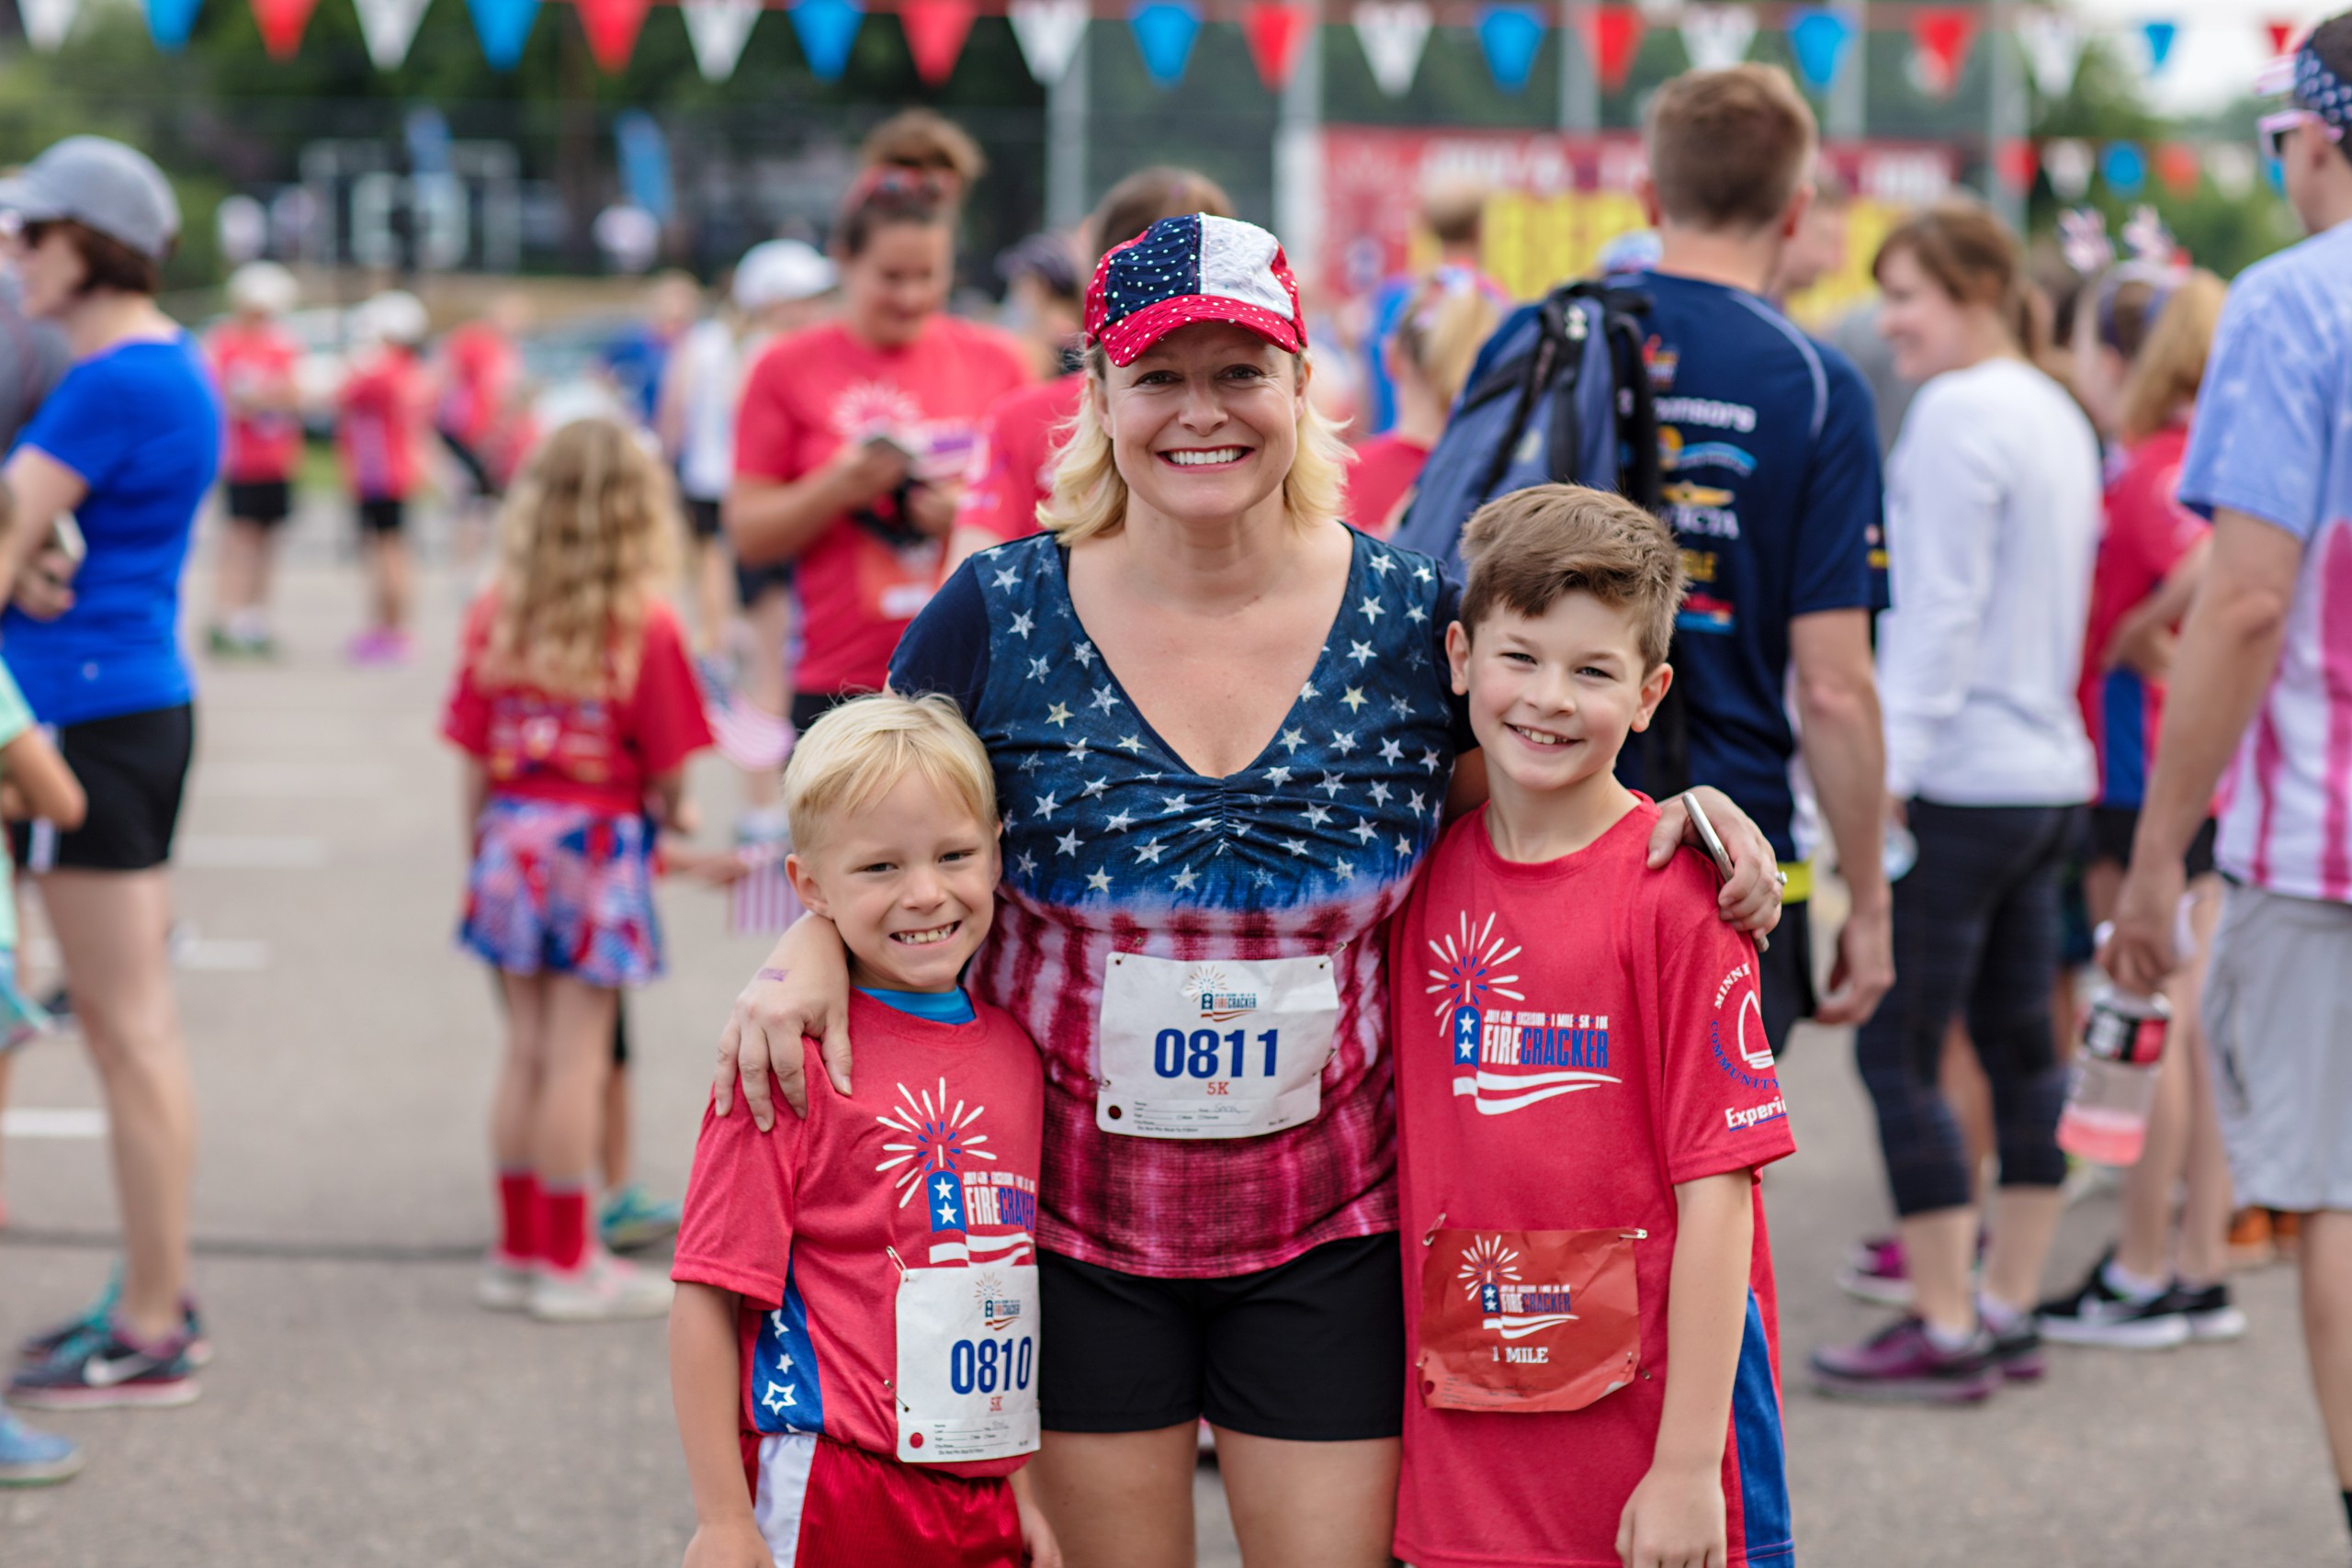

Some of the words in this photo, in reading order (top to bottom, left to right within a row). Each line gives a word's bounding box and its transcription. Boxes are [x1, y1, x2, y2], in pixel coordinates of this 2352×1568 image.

[1154, 1029, 1278, 1078] 0811
[1482, 1025, 1608, 1068] FIRECRACKER
[1206, 1081, 1229, 1096] 5K
[1500, 1293, 1571, 1313] FIRECRACKER
[1492, 1346, 1499, 1361] 1
[1505, 1347, 1549, 1363] MILE
[951, 1336, 1032, 1394] 0810
[989, 1396, 1003, 1411] 5K
